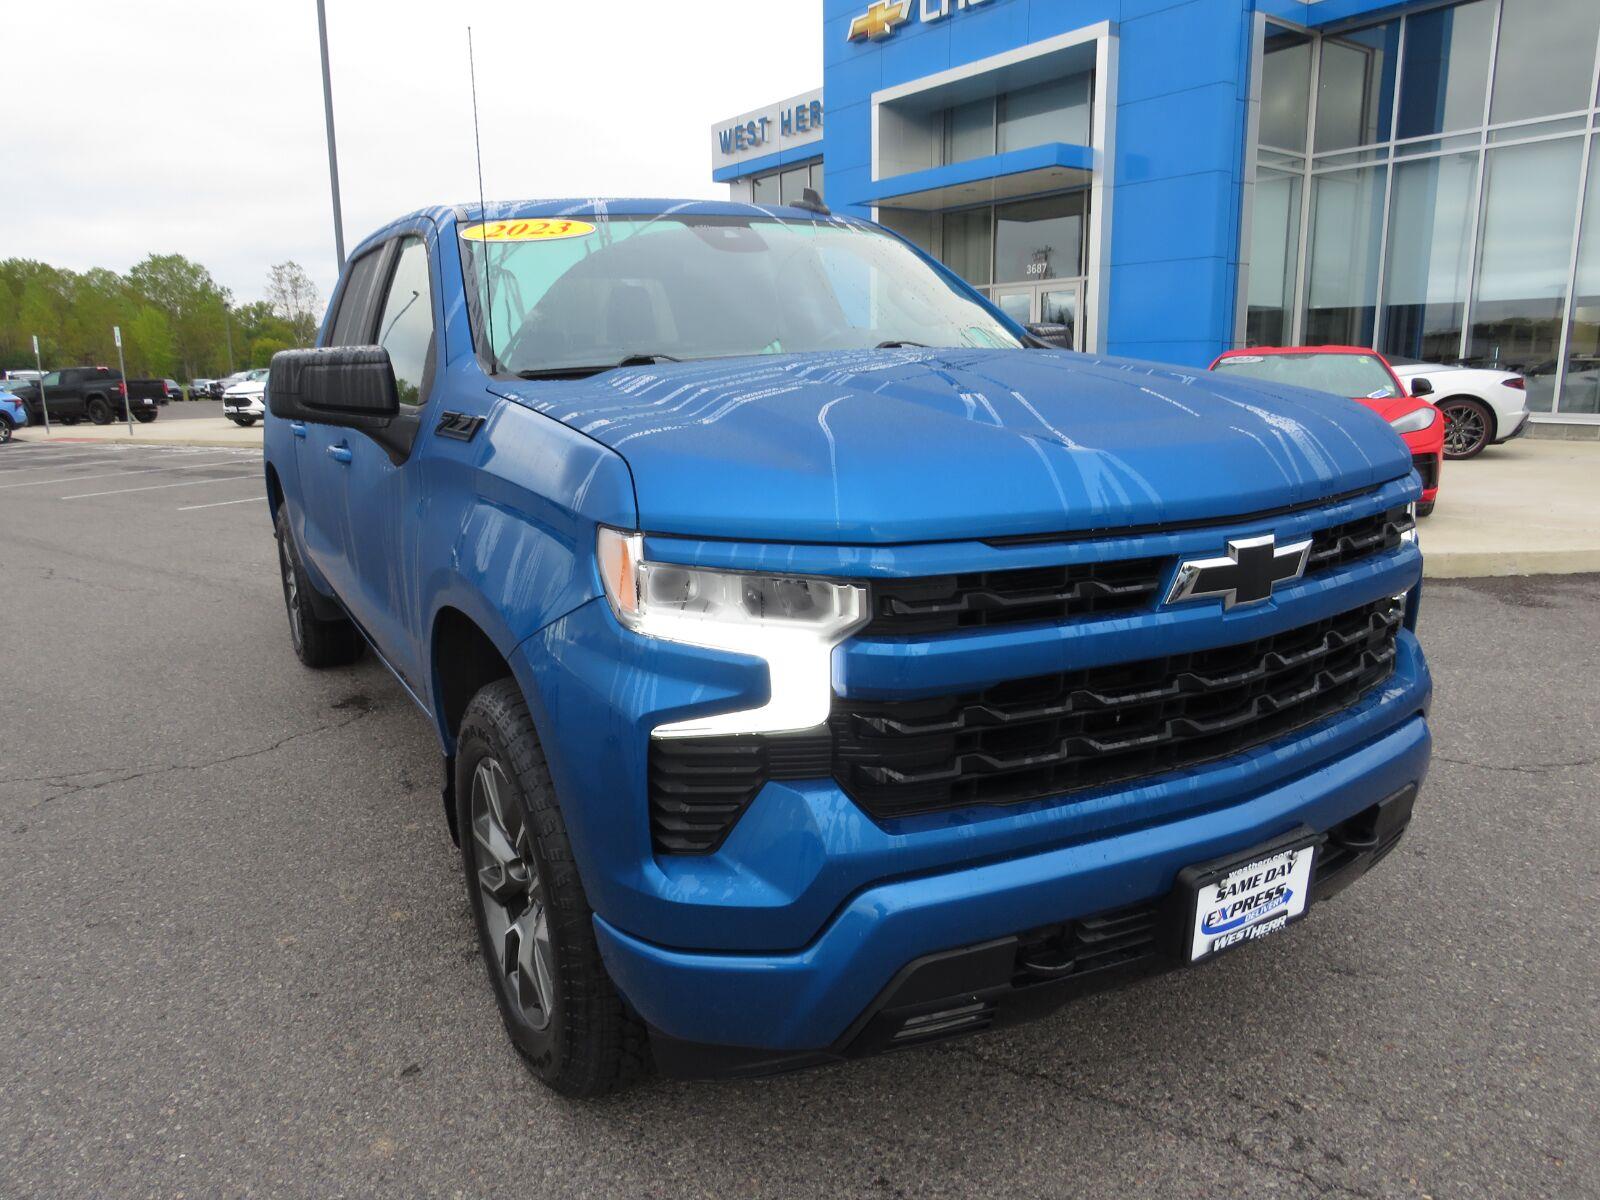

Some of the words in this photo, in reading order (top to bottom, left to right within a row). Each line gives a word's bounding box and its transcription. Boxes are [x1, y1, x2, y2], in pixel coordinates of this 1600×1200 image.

[719, 117, 768, 155] WEST
[486, 222, 572, 238] 2023
[1026, 262, 1047, 275] 3687
[435, 411, 486, 442] Z71
[1215, 873, 1263, 903] SAME
[1264, 859, 1298, 884] DAY
[1206, 882, 1287, 928] EXPRESS
[1245, 896, 1284, 922] DELIVERY
